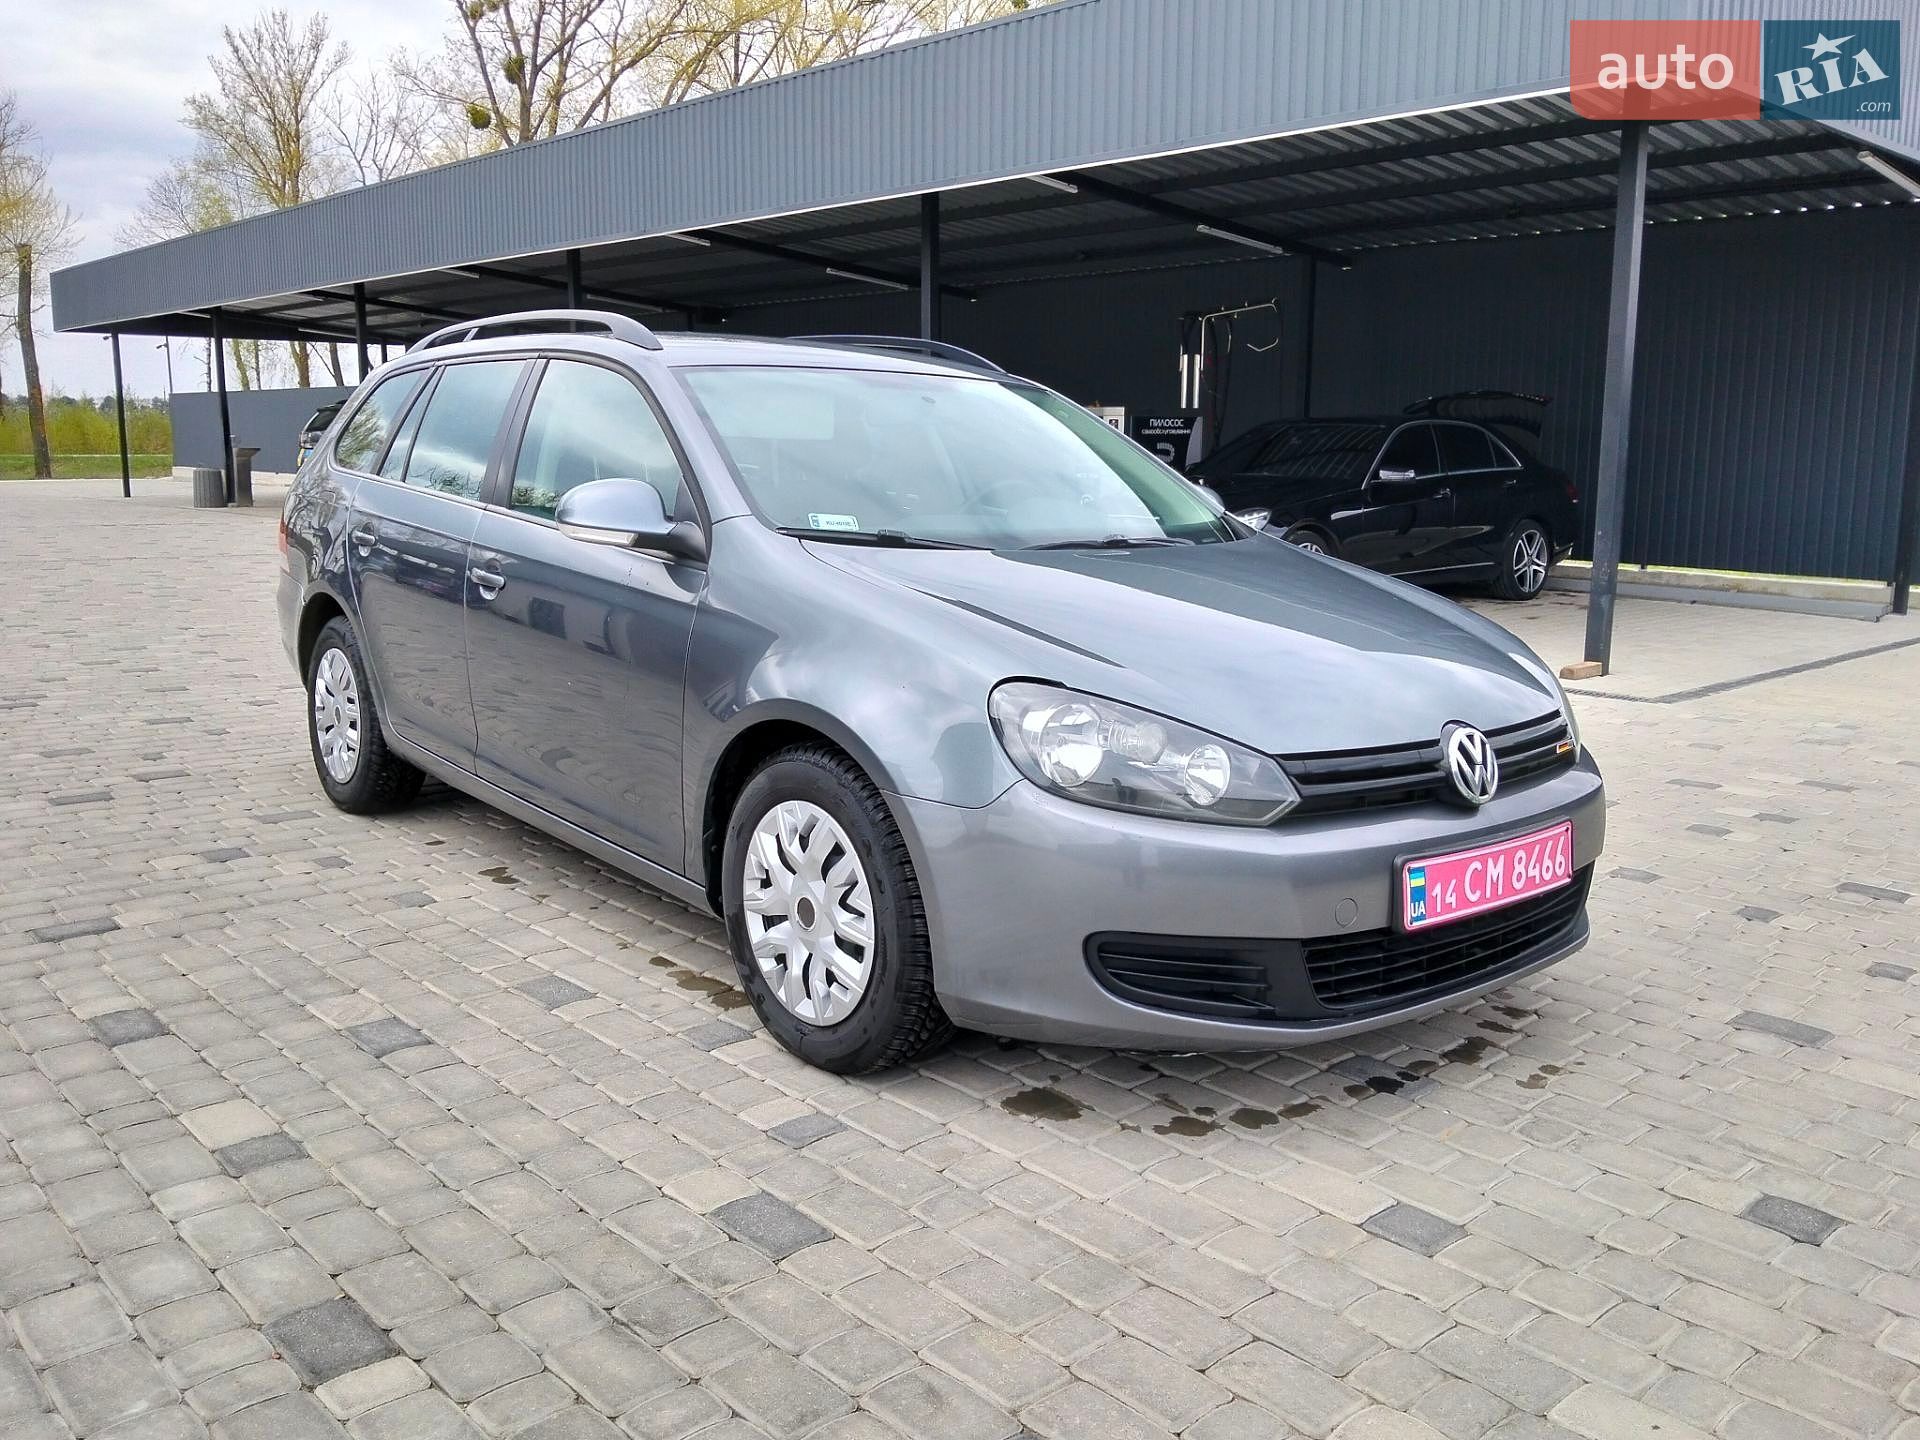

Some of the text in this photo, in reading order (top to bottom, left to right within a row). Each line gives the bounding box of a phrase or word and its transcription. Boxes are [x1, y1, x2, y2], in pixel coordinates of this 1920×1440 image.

[1149, 418, 1184, 427] ПИЛОСОС
[1431, 879, 1457, 913] 14
[1511, 836, 1566, 891] 8466
[1410, 900, 1427, 917] UA
